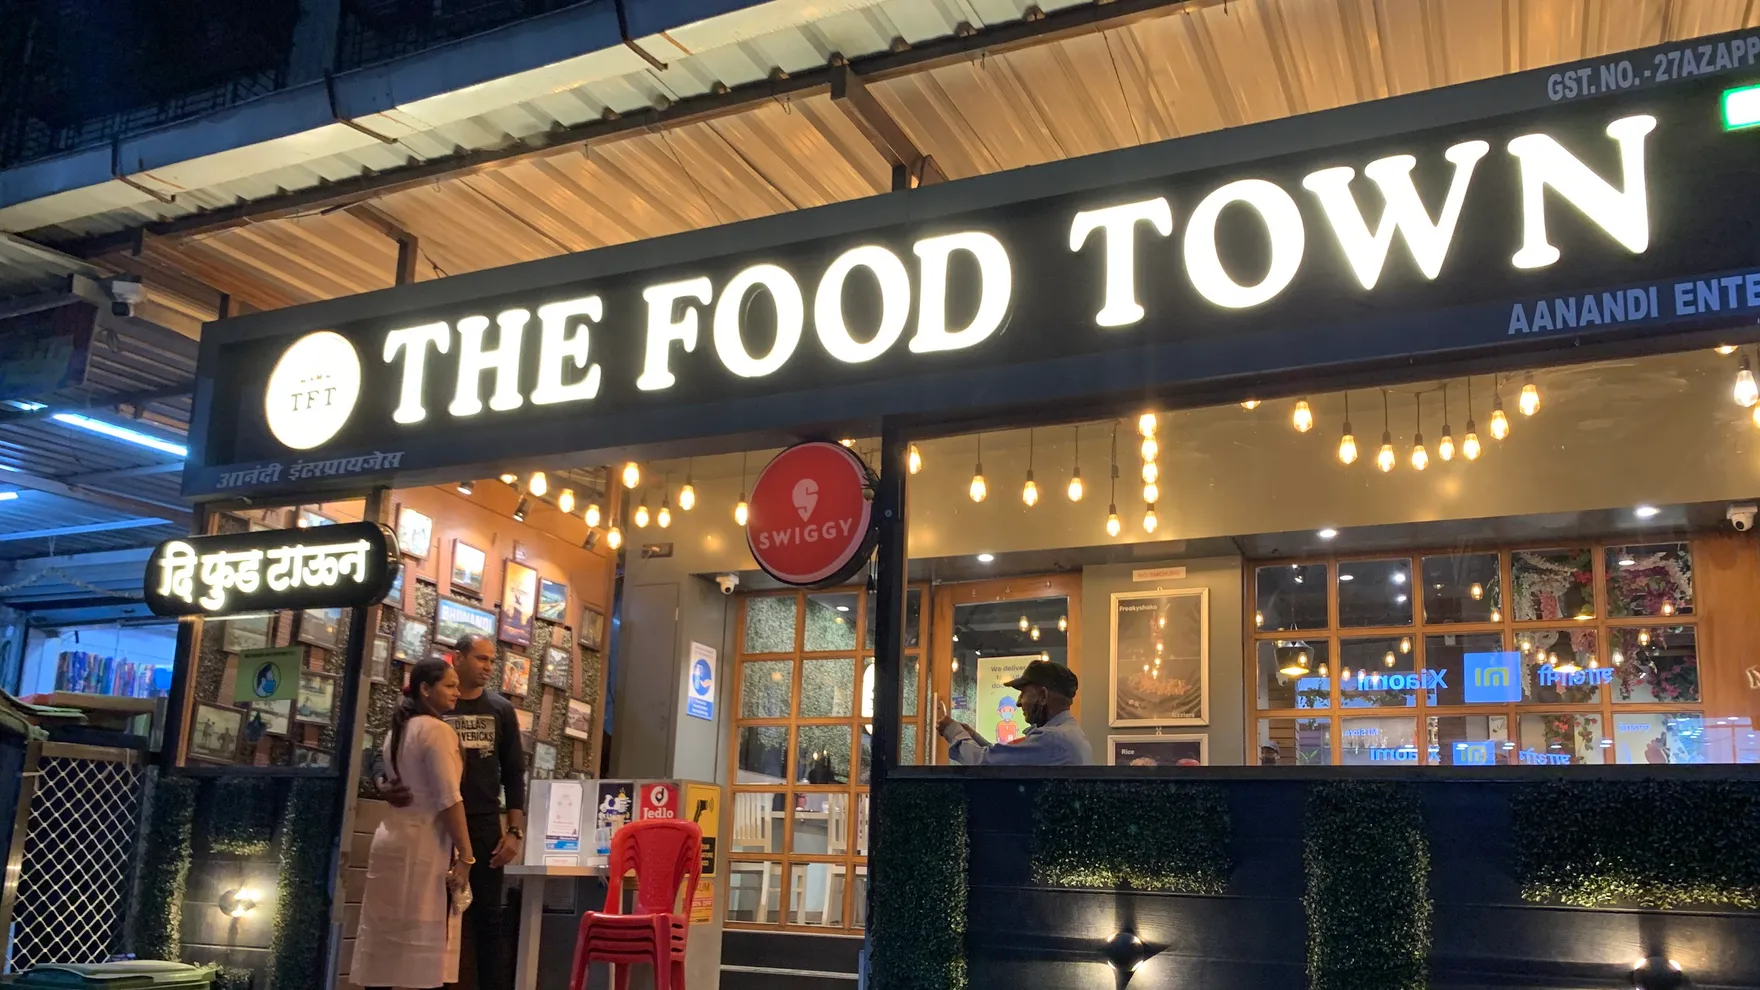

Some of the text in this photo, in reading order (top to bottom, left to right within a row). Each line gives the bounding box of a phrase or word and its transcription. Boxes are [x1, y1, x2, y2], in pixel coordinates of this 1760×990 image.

[1547, 67, 1596, 101] GST.
[1600, 60, 1640, 93] NO.
[383, 114, 1658, 424] THE FOOD TOWN
[1508, 286, 1659, 335] AANANDI
[291, 387, 336, 412] TFT
[216, 451, 405, 489] आनंदी इंटरप्रायजेस
[758, 518, 853, 550] SWIGGY
[158, 538, 371, 611] दि फुड टाऊन
[454, 720, 487, 730] DALLAS
[1121, 748, 1135, 756] Rice
[643, 807, 674, 820] Jedlo
